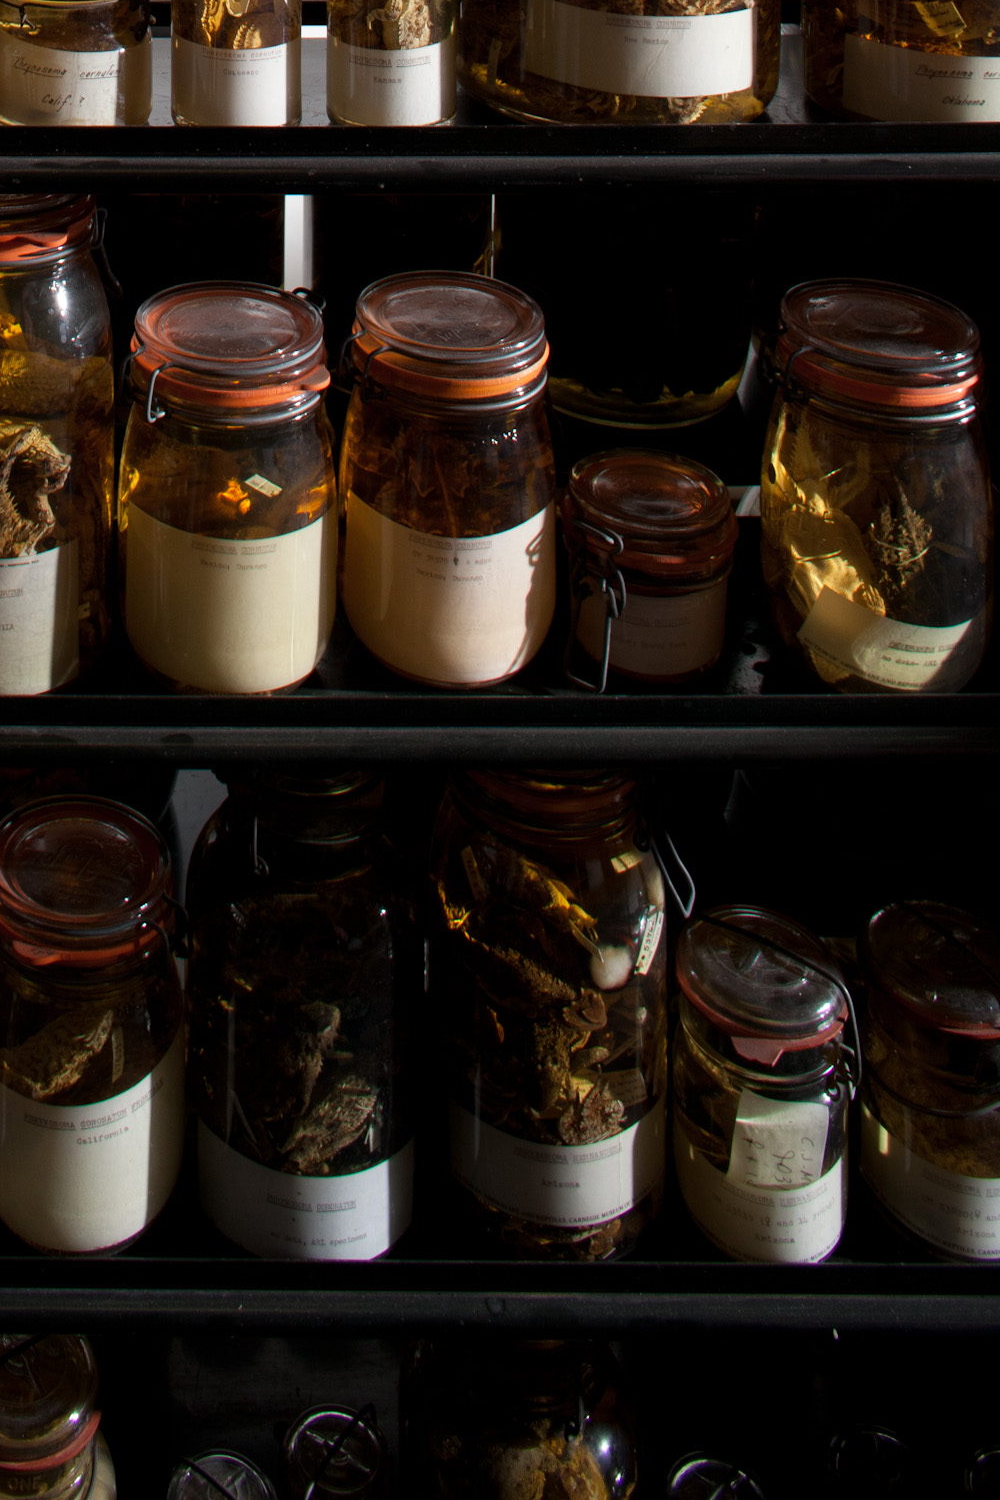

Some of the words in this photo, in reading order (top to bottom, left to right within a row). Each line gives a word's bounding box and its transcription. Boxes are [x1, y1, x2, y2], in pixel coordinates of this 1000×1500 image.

[41, 93, 73, 109] Calif.
[942, 96, 986, 107] Oklahoma
[77, 1125, 130, 1145] California
[541, 1179, 580, 1188] Arizona
[569, 1214, 600, 1223] CARNEGIE
[602, 1206, 624, 1218] MUSEUM
[311, 1237, 326, 1246] ARL
[330, 1231, 367, 1247] specimens
